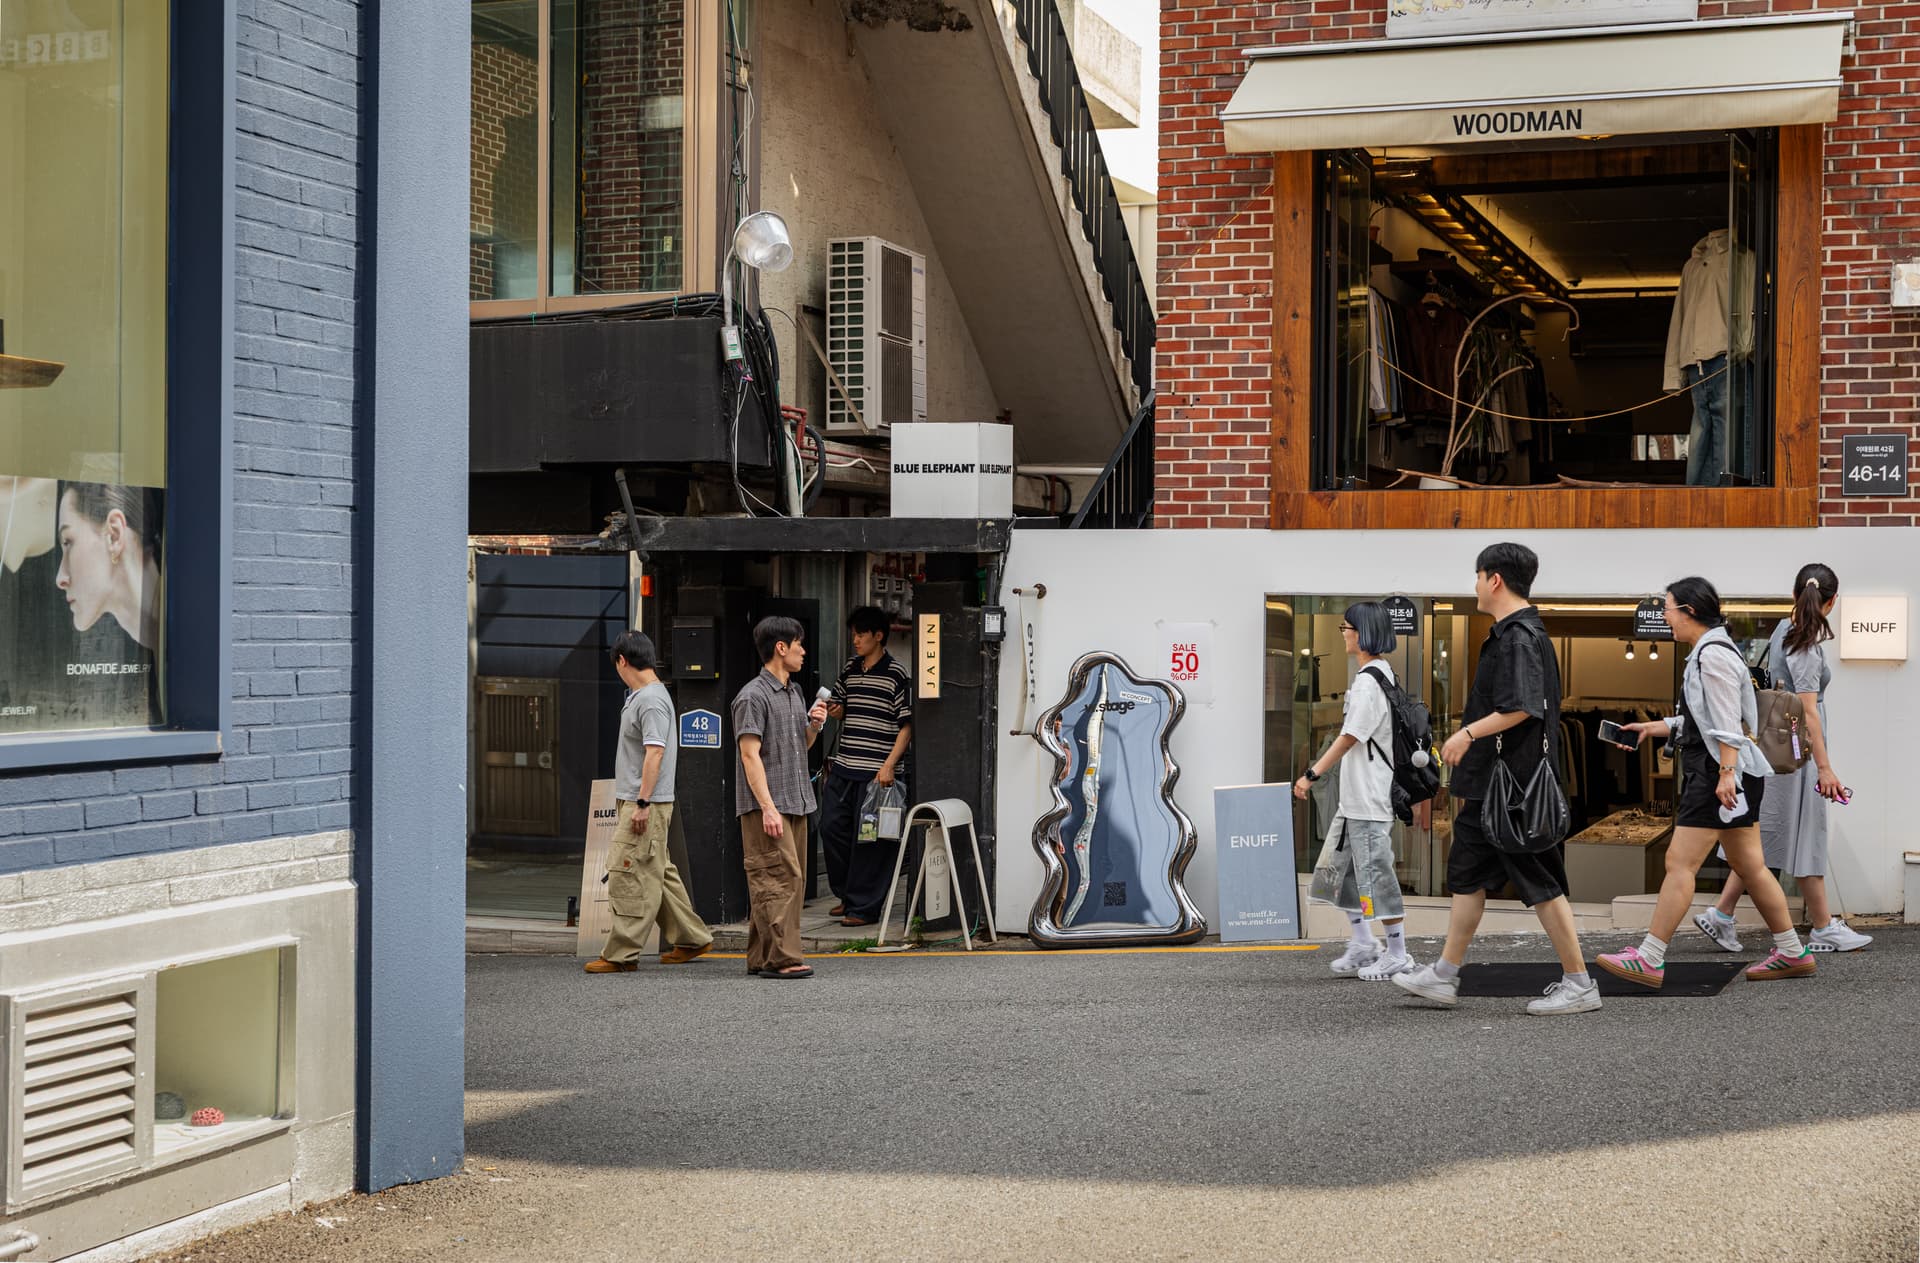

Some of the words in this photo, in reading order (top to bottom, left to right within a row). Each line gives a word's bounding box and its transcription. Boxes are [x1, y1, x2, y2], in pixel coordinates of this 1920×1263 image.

[1453, 108, 1582, 136] WOODMAN
[894, 463, 919, 473] BLUE
[922, 463, 975, 473] ELEPHANT
[980, 463, 991, 473] BLUE
[991, 464, 1012, 474] ELEPHANT
[1848, 465, 1901, 482] 46-14
[1387, 608, 1413, 617] 리조심
[1638, 609, 1666, 619] 머리조
[1851, 622, 1896, 633] ENUFF
[1172, 643, 1196, 652] SALE
[927, 623, 936, 688] JAEIN
[1027, 623, 1036, 704] enuff
[1171, 653, 1199, 672] 50
[66, 663, 118, 675] BONAFIDE
[119, 664, 152, 674] JEWELRY
[1170, 672, 1198, 681] %OFF
[691, 716, 708, 730] 48
[593, 809, 617, 819] BLUE
[1230, 834, 1279, 849] ENUFF
